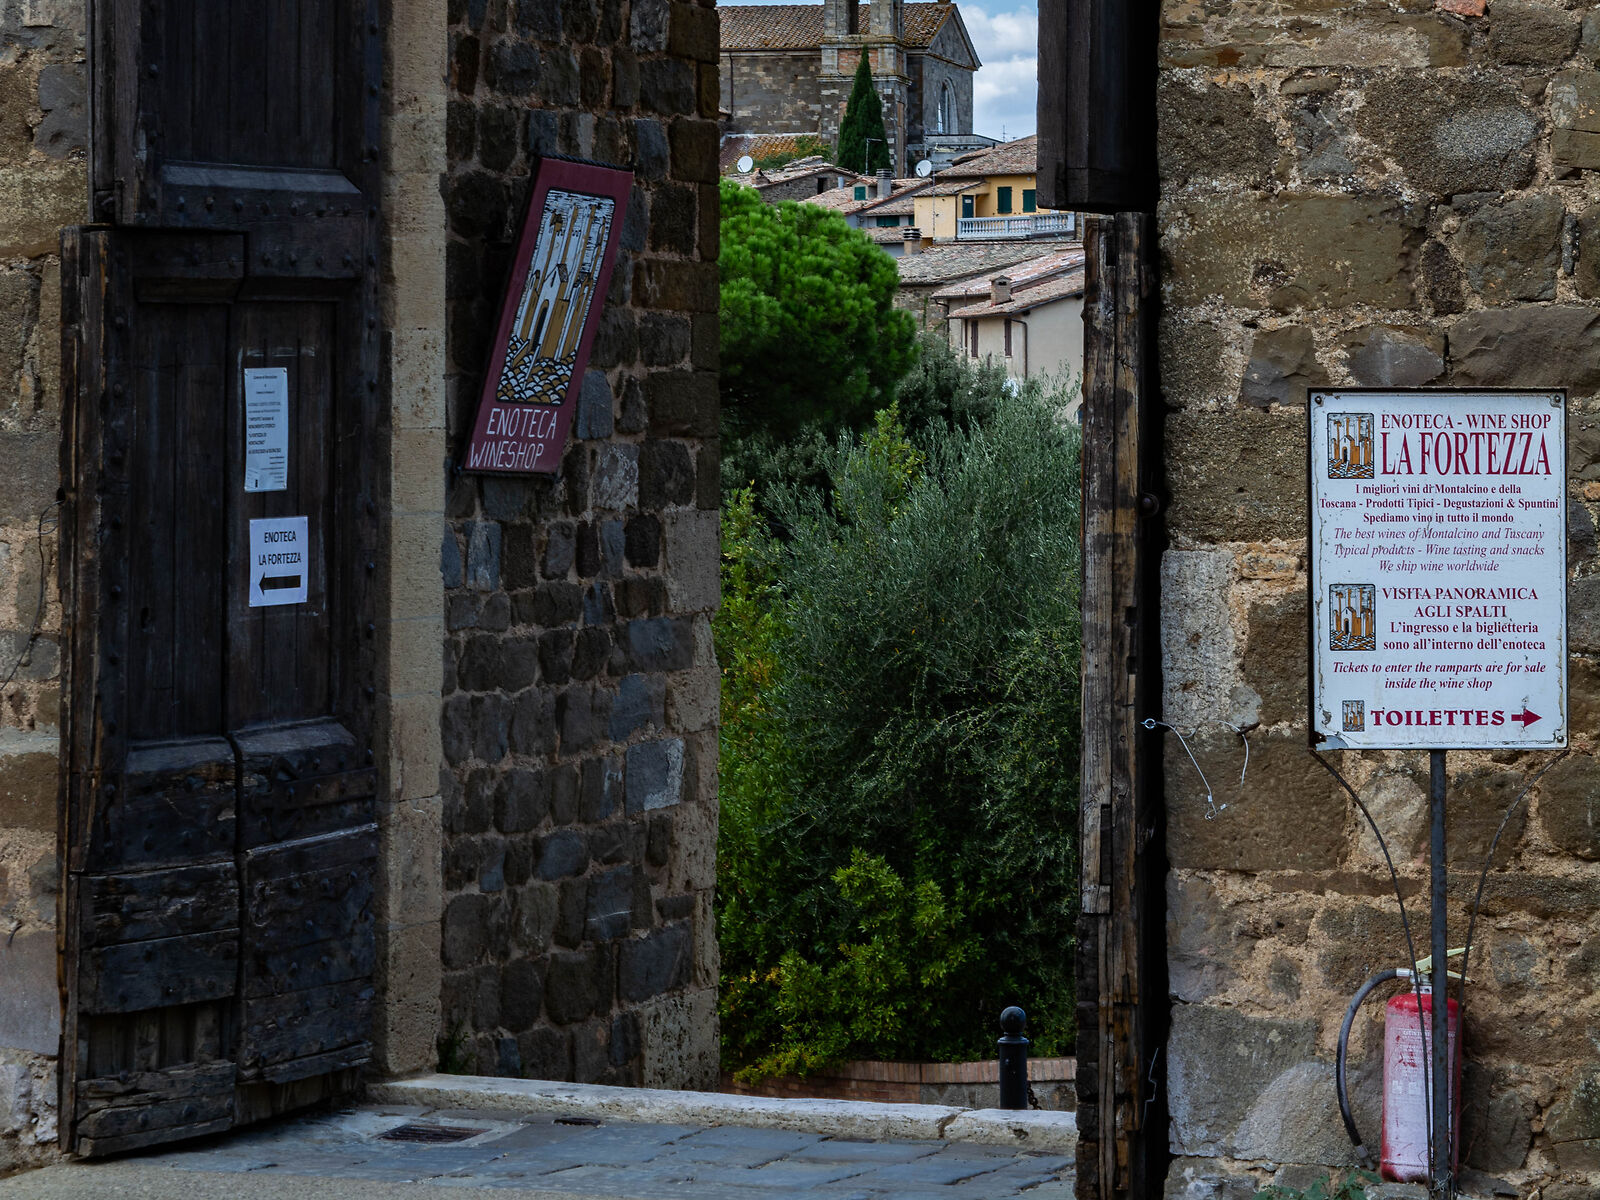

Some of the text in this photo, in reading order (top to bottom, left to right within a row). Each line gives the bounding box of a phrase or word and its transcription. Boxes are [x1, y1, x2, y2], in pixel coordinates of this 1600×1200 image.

[486, 408, 557, 440] ENOTECA
[1381, 414, 1454, 429] ENOTECA
[1467, 414, 1507, 429] WINE
[1511, 414, 1551, 429] SHOP
[469, 440, 545, 469] WINESHOP
[1381, 432, 1552, 476] LA FORTEZZA
[1356, 485, 1360, 494] I
[1363, 484, 1399, 496] migliori
[1403, 485, 1420, 494] vini
[1423, 484, 1433, 494] di
[1435, 484, 1488, 494] Montalcino
[1499, 484, 1521, 494] della
[1320, 499, 1356, 509] Toscana
[1366, 499, 1405, 509] Prodotti
[1408, 499, 1434, 511] Tipici
[1444, 499, 1504, 511] Degustazioni
[1507, 499, 1515, 509] &
[1519, 499, 1559, 512] Spuntini
[1363, 513, 1514, 525] Spediamo vino in tutto il mondo
[264, 531, 296, 544] ENOTECA
[1335, 528, 1544, 542] The best wines of Montalcino and Tuscany
[259, 550, 301, 566] LA FORTEZZA
[1335, 545, 1370, 557] Typical
[1372, 545, 1415, 558] products
[1426, 545, 1450, 555] Wine
[1453, 545, 1486, 558] tasting
[1490, 545, 1508, 555] and
[1512, 545, 1545, 555] snacks
[1379, 561, 1500, 575] We ship wine worldwide
[1382, 588, 1538, 600] VISITA PANORAMICA
[1414, 606, 1507, 618] AGLI SPALTI
[1453, 625, 1458, 633] e
[1462, 622, 1472, 633] la
[1476, 622, 1538, 636] biglietteria
[1384, 641, 1410, 650] sono
[1333, 662, 1546, 675] Tickets to enter the ramparts are for sale
[1385, 678, 1492, 692] inside the wine shop
[1371, 710, 1505, 726] TOILETTES
